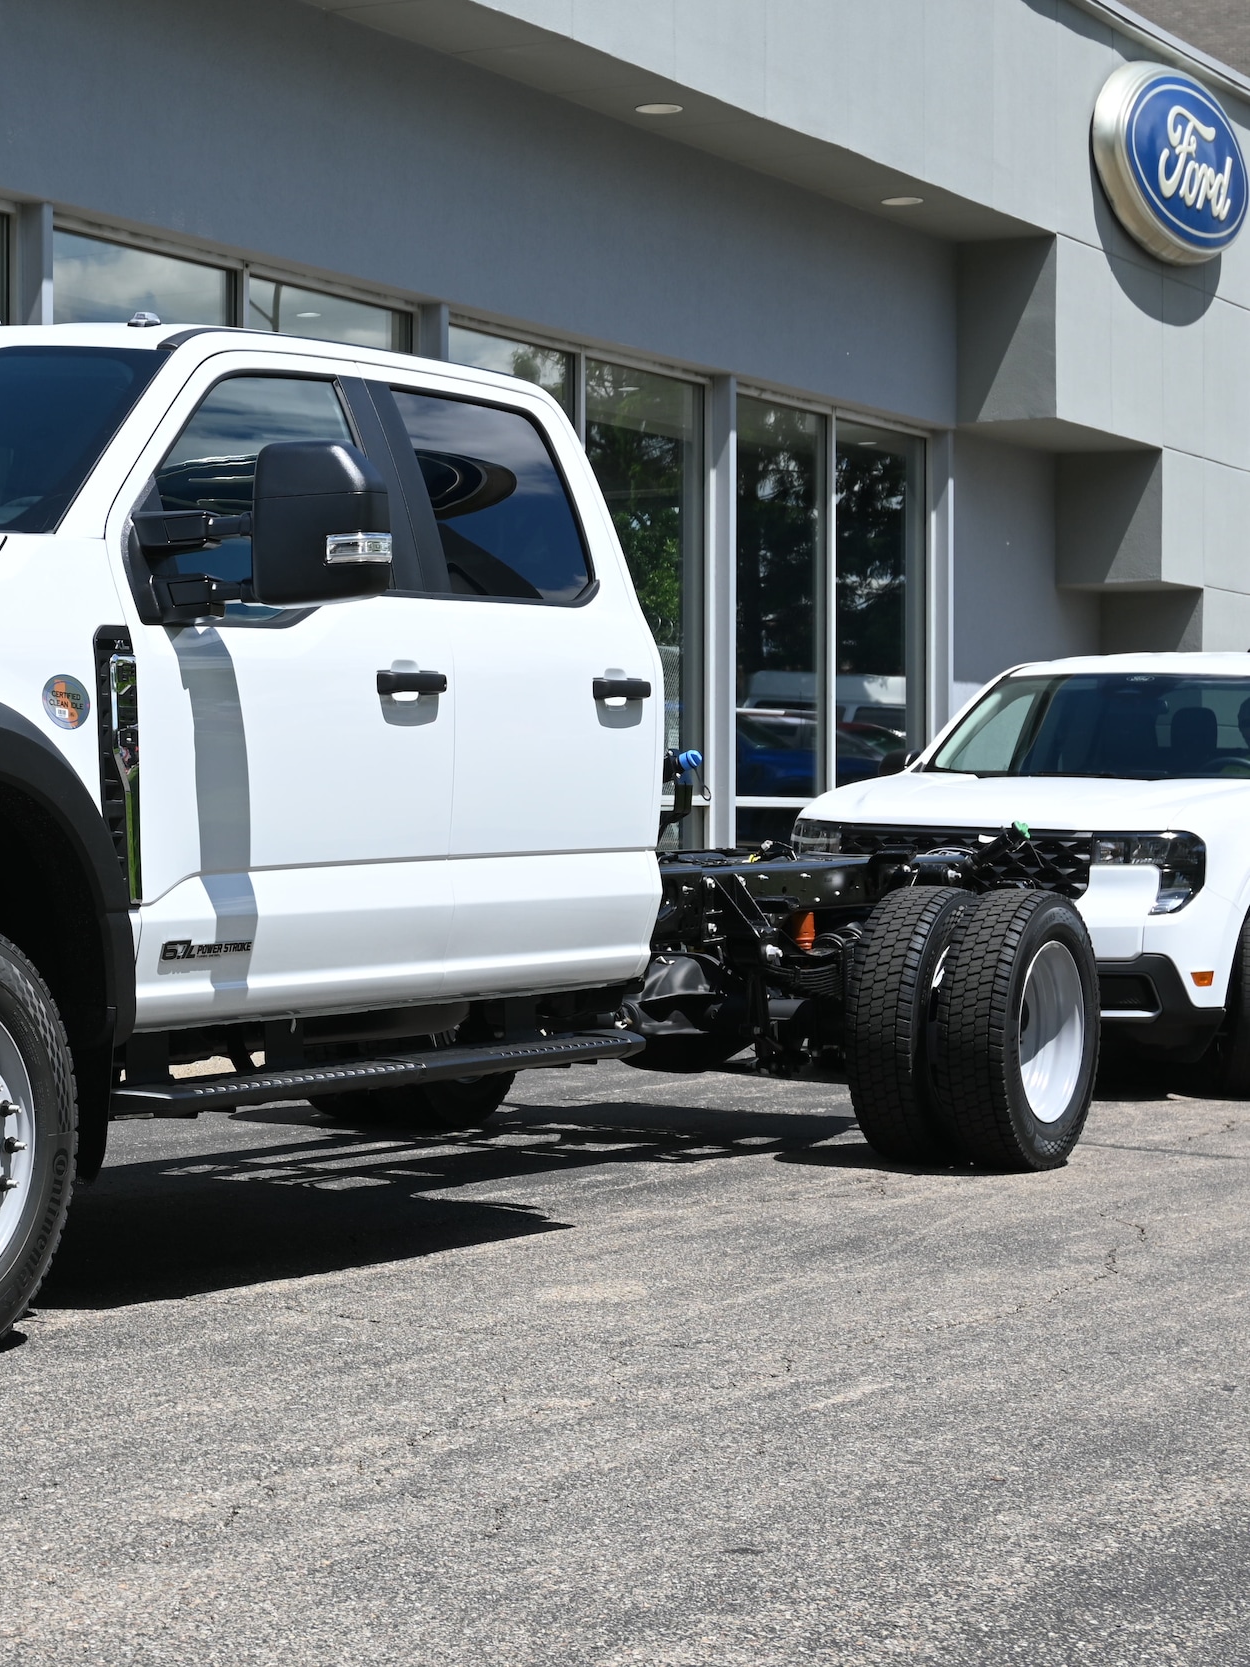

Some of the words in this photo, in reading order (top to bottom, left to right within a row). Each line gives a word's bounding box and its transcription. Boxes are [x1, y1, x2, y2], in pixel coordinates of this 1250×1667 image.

[1158, 105, 1233, 221] Ford
[113, 639, 130, 650] XL
[51, 690, 82, 701] CERTIFIED
[48, 699, 69, 709] CLEAN
[71, 701, 84, 711] IDLE
[161, 940, 195, 960] 6.7L
[196, 944, 223, 954] POWER
[223, 942, 252, 953] STROKE
